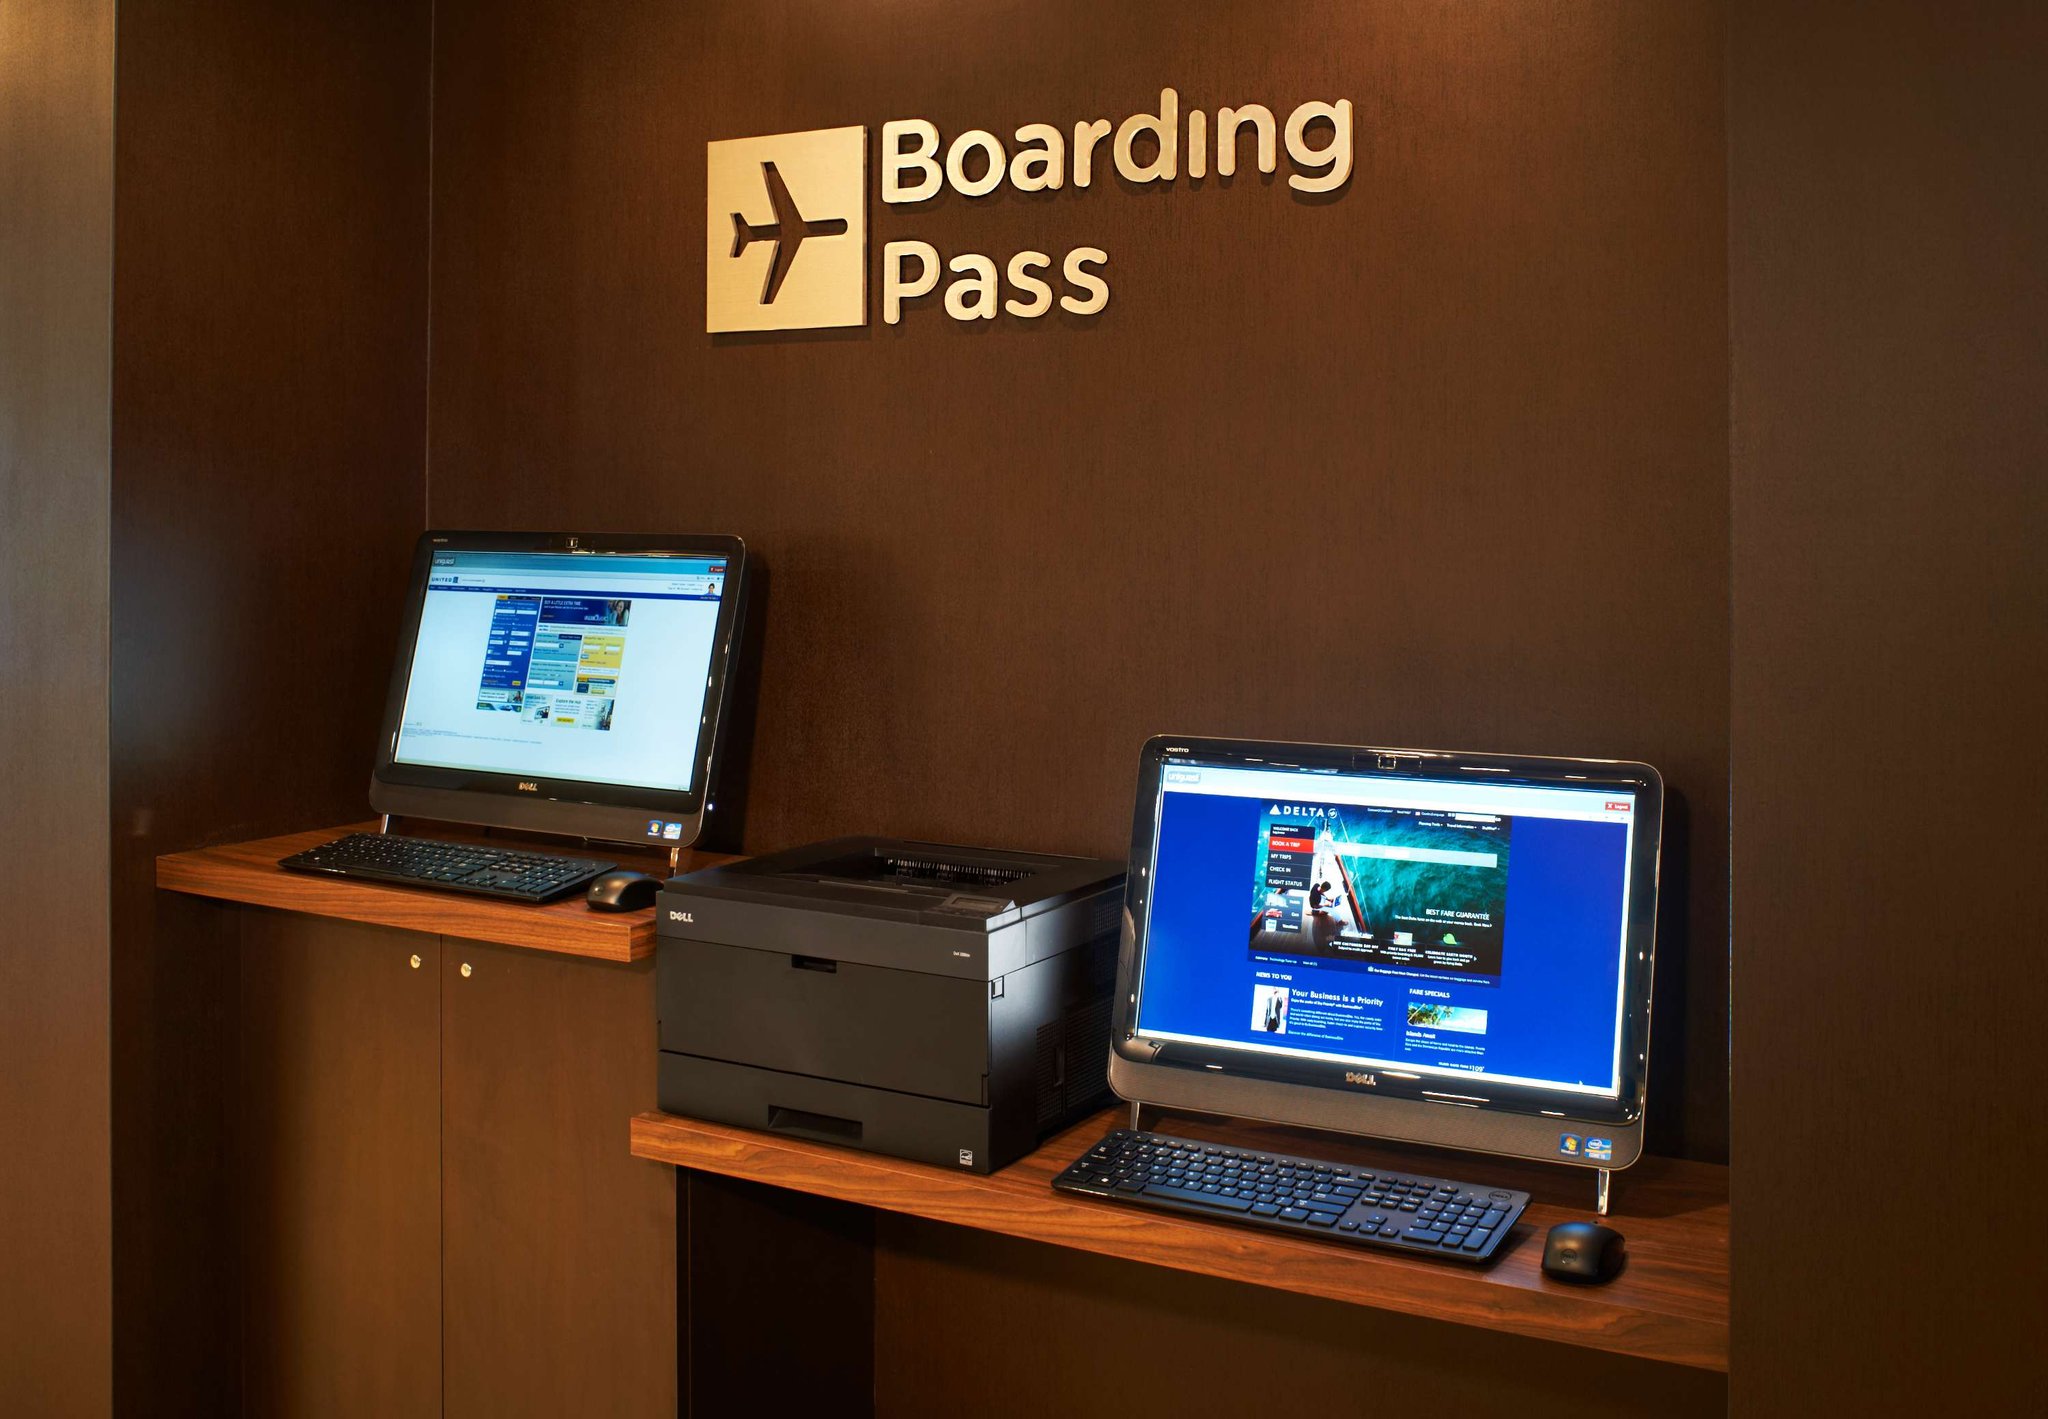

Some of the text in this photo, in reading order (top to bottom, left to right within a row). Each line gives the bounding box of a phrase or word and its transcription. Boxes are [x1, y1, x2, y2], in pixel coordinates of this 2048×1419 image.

[882, 88, 1353, 203] Boarding
[884, 240, 1109, 325] Pass
[1283, 806, 1325, 817] DELTA
[670, 911, 693, 922] DELL
[1426, 908, 1440, 916] BEST
[1291, 988, 1308, 997] Your
[1310, 991, 1340, 1001] Business
[1342, 994, 1348, 1002] is
[1357, 996, 1383, 1007] Priority
[1409, 988, 1424, 996] FARE
